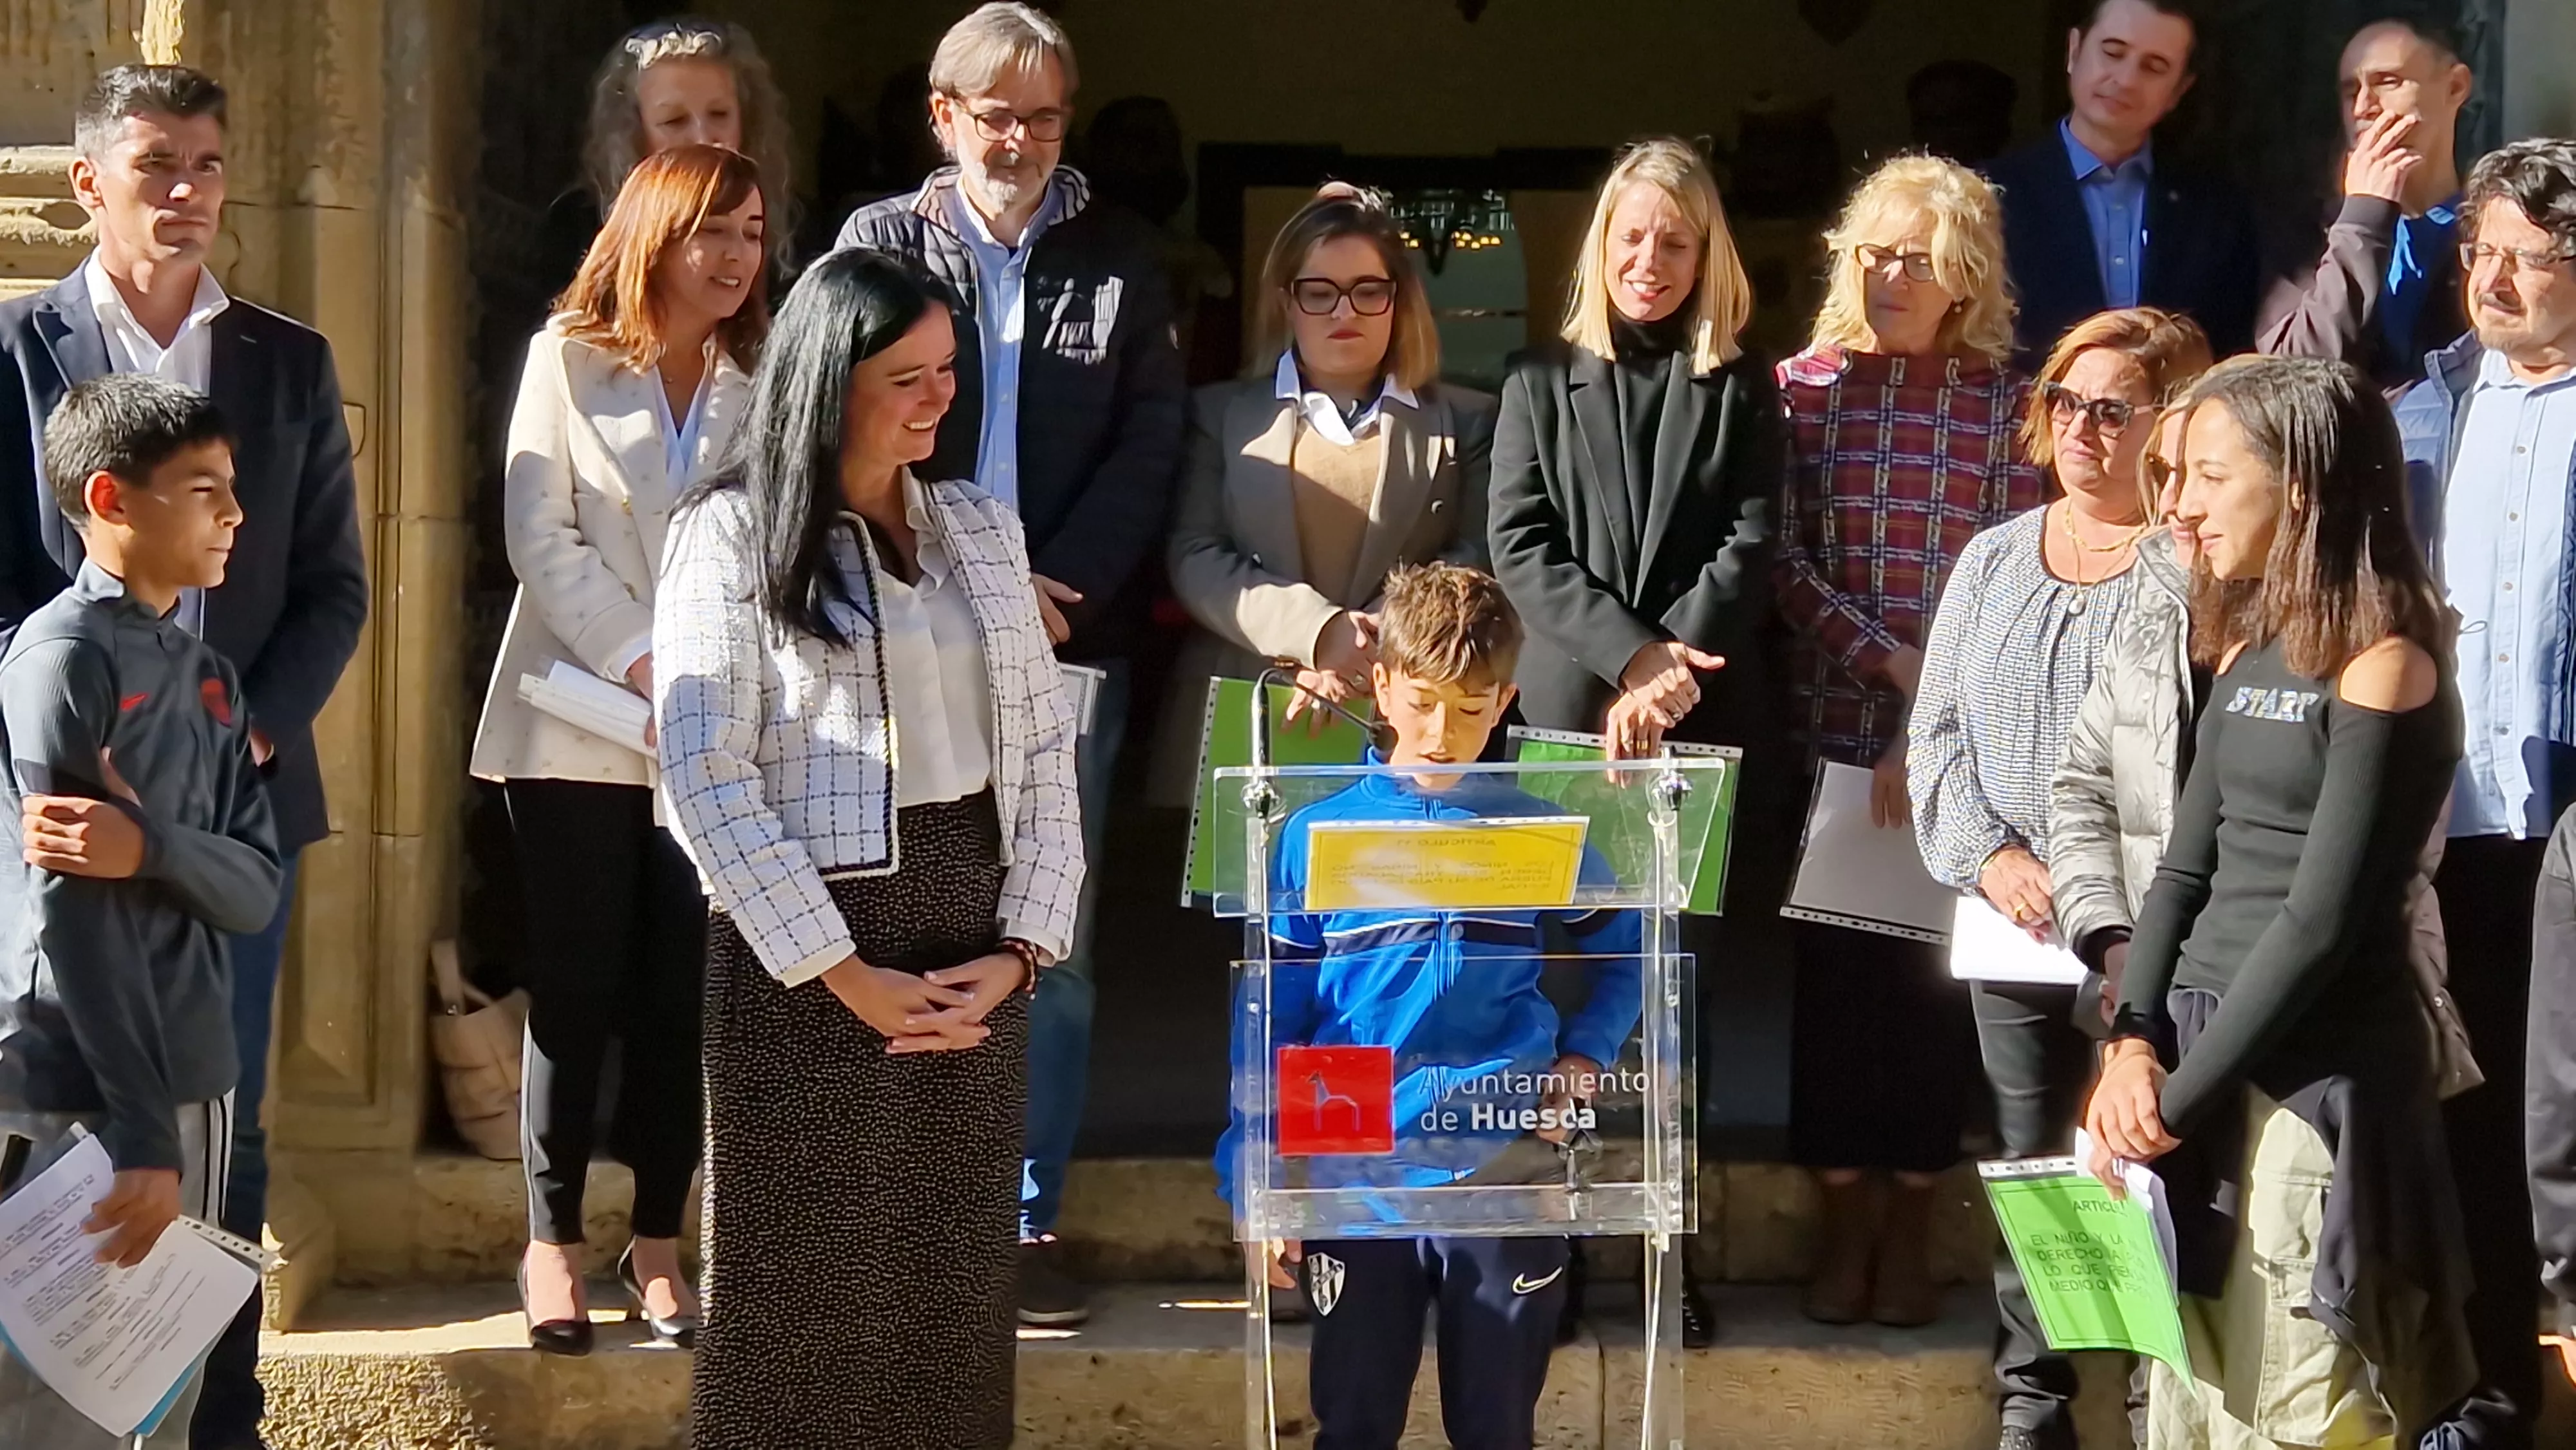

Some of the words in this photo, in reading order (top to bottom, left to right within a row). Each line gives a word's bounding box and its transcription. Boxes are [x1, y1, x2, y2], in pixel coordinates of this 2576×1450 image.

[1419, 1066, 1651, 1102] Ayuntamiento
[1421, 1106, 1459, 1132] de
[1471, 1102, 1596, 1131] Huesca
